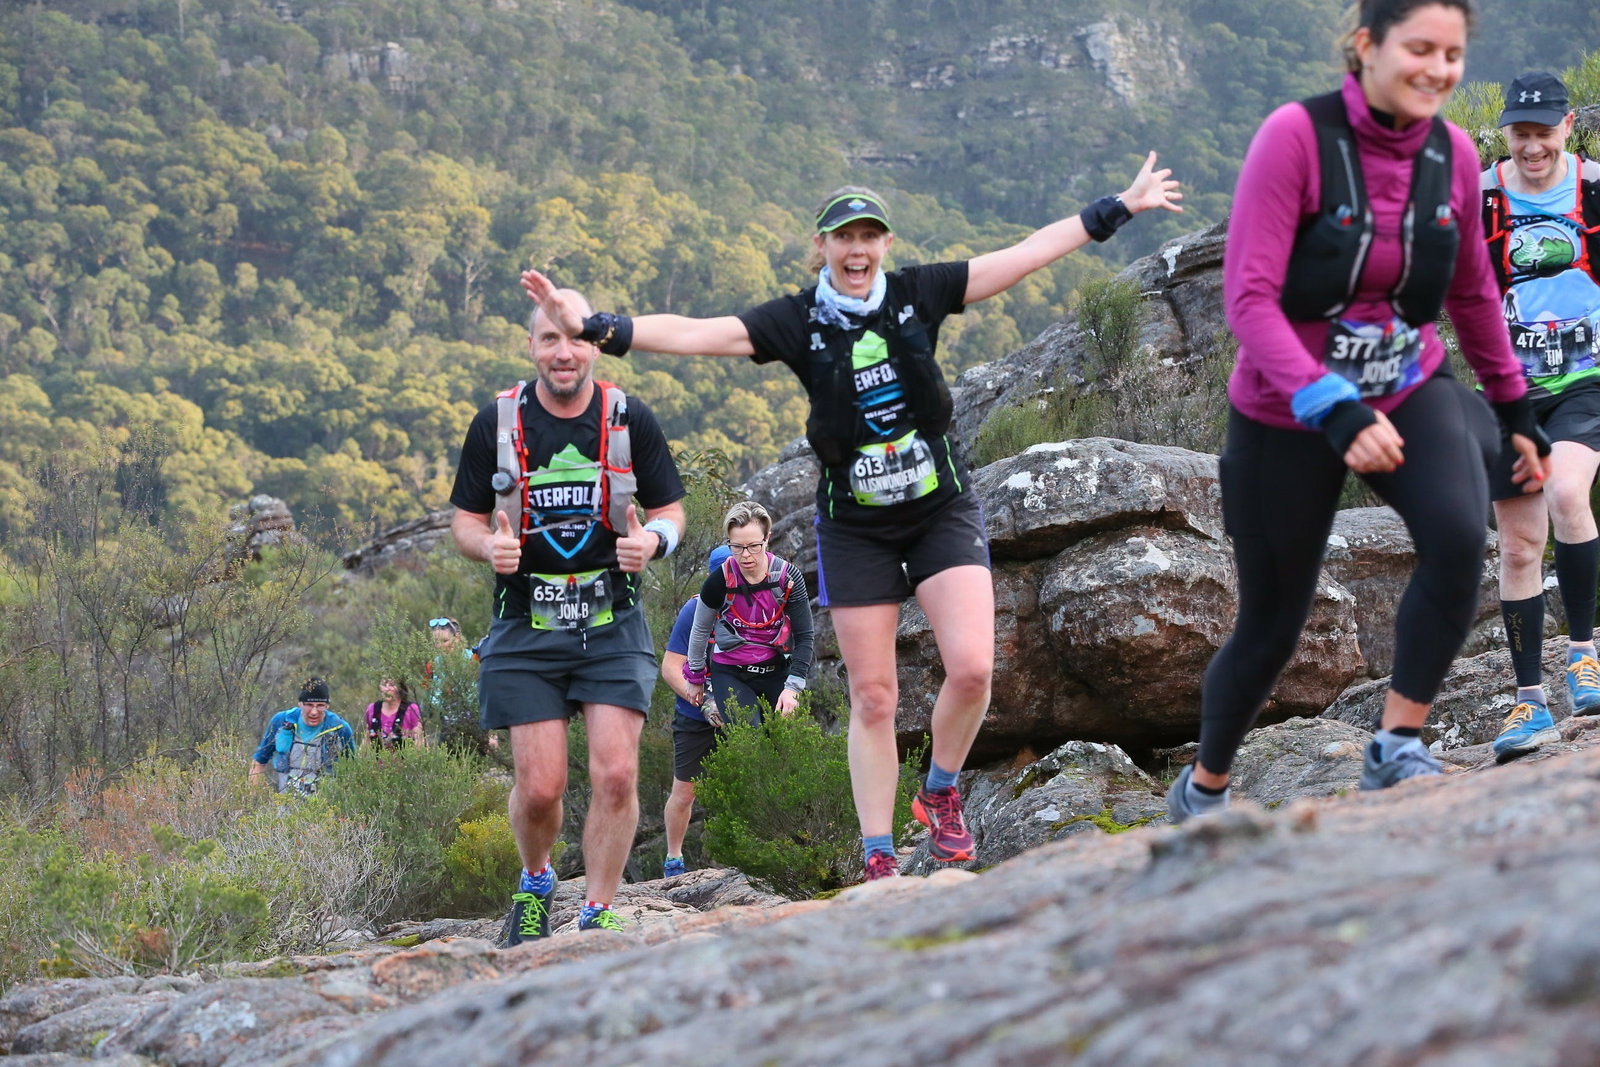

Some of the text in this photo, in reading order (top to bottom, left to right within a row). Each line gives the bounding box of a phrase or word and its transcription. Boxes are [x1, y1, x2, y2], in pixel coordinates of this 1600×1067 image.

[1331, 334, 1378, 361] 377
[1516, 332, 1546, 348] 472
[854, 456, 885, 478] 613
[533, 585, 566, 602] 652
